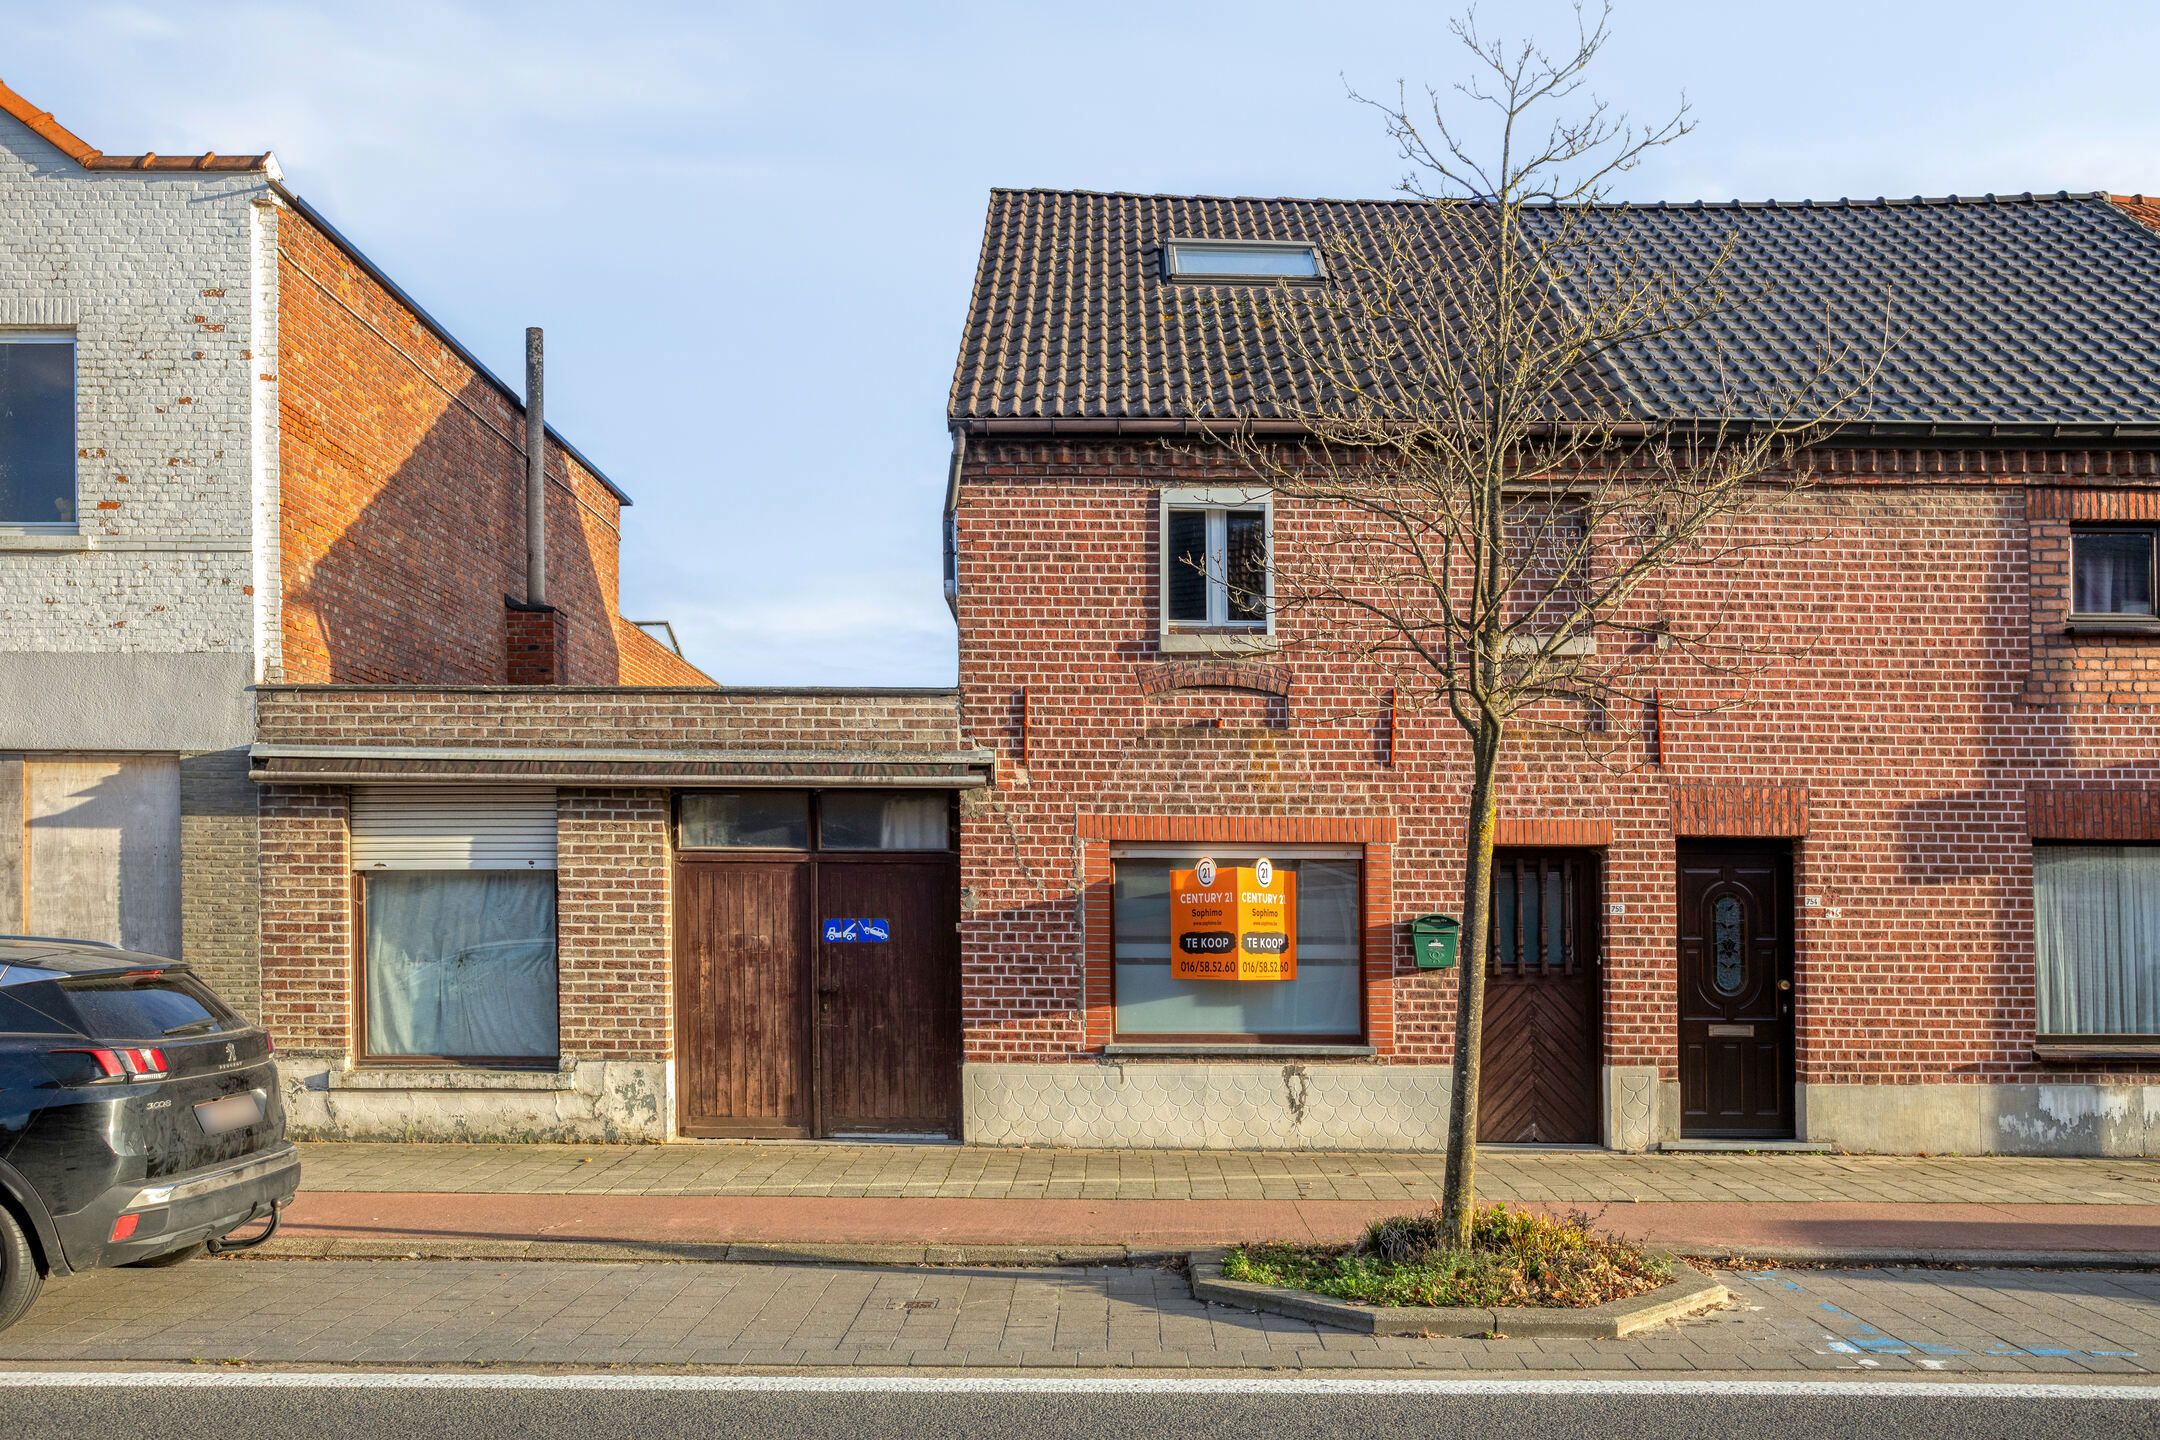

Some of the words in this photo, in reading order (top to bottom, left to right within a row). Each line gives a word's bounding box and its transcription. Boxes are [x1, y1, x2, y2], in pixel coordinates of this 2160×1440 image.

[1180, 892, 1223, 904] CENTURY
[1224, 892, 1233, 903] 21
[1241, 892, 1278, 904] CENTURY
[1279, 894, 1287, 905] 21
[1191, 908, 1223, 919] Sophimo
[1251, 908, 1279, 919] Sophimo
[1186, 937, 1198, 948] TE
[1200, 937, 1229, 948] KOOP
[1247, 937, 1258, 949] TE
[1260, 937, 1284, 949] KOOP
[1180, 960, 1236, 973] 016/58.52.60
[1242, 960, 1289, 973] 016/58.52.60
